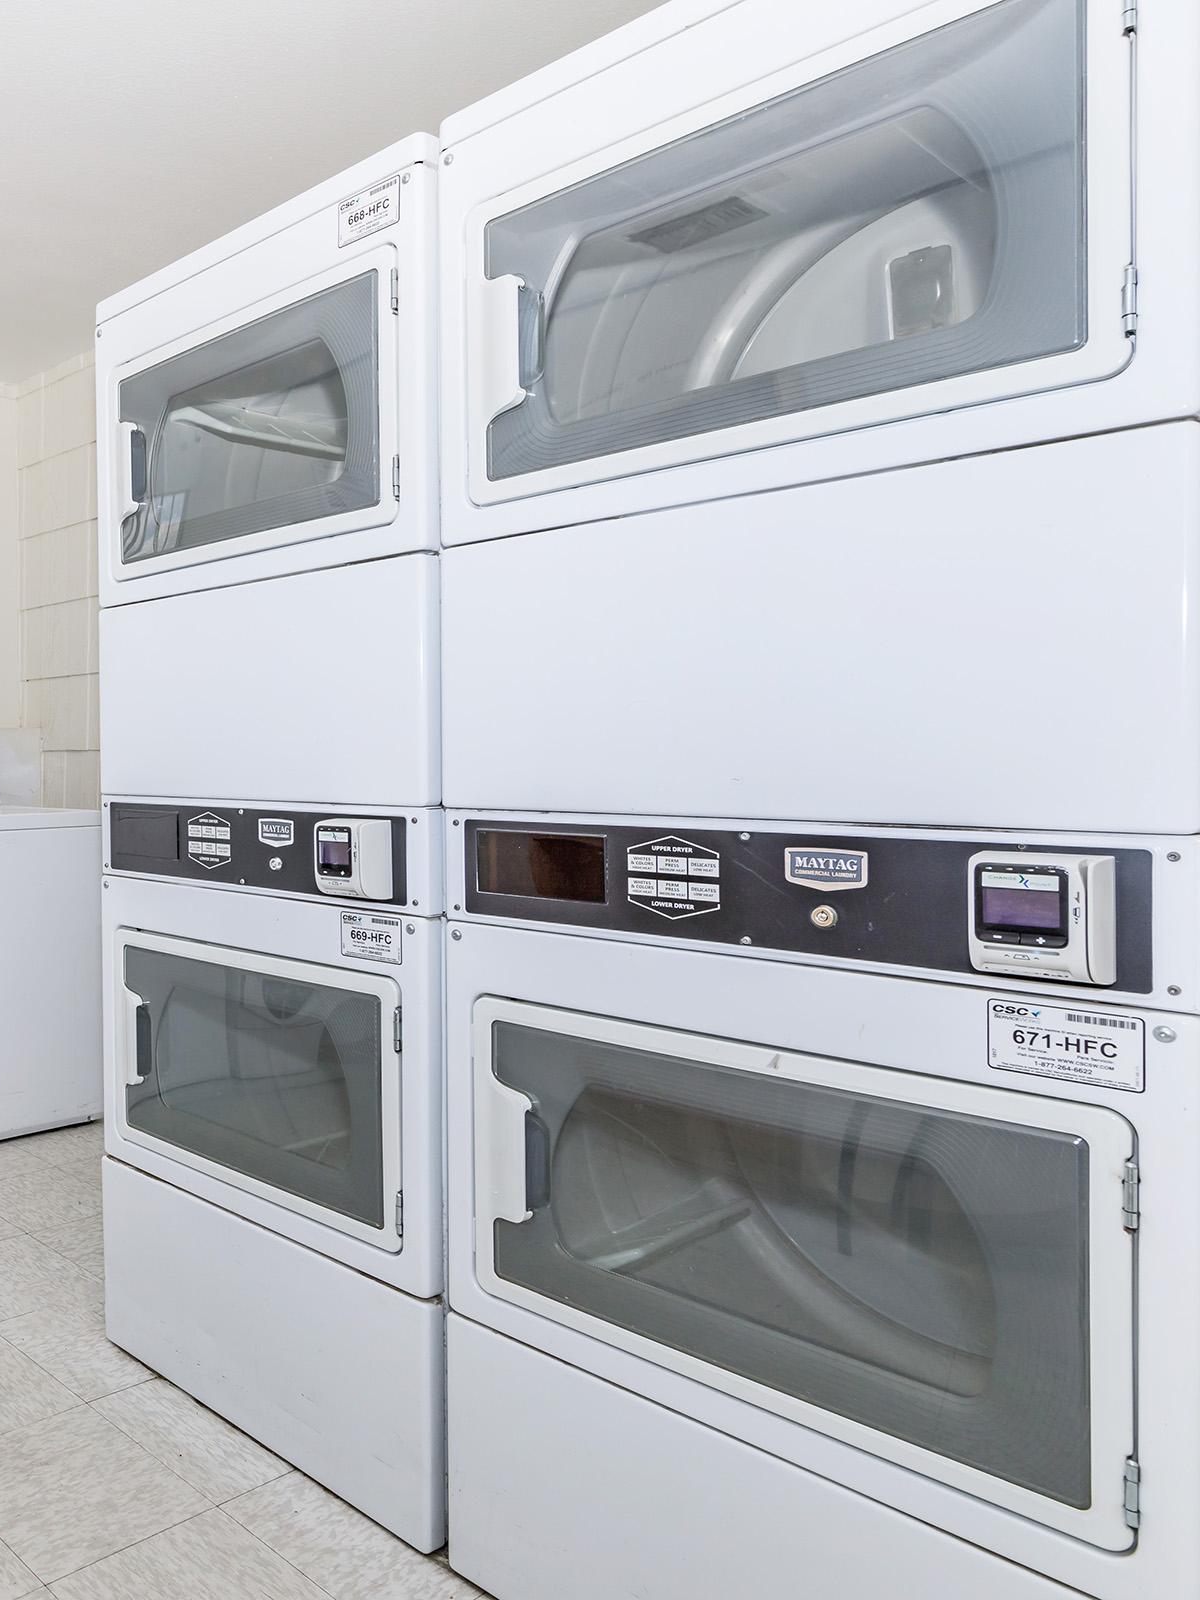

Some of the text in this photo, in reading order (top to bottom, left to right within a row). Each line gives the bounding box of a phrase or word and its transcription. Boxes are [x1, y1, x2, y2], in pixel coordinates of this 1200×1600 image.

[348, 198, 390, 225] 668-HFC
[262, 824, 290, 833] MAYTAG
[794, 856, 858, 871] MAYTAG
[794, 868, 830, 876] COMMERCIAL
[674, 902, 694, 910] DRYER
[351, 930, 392, 945] 669-HFC
[992, 1004, 1029, 1016] CSC
[1013, 1029, 1118, 1058] 671-HFC
[1035, 1061, 1093, 1074] 1-877-264-6622
